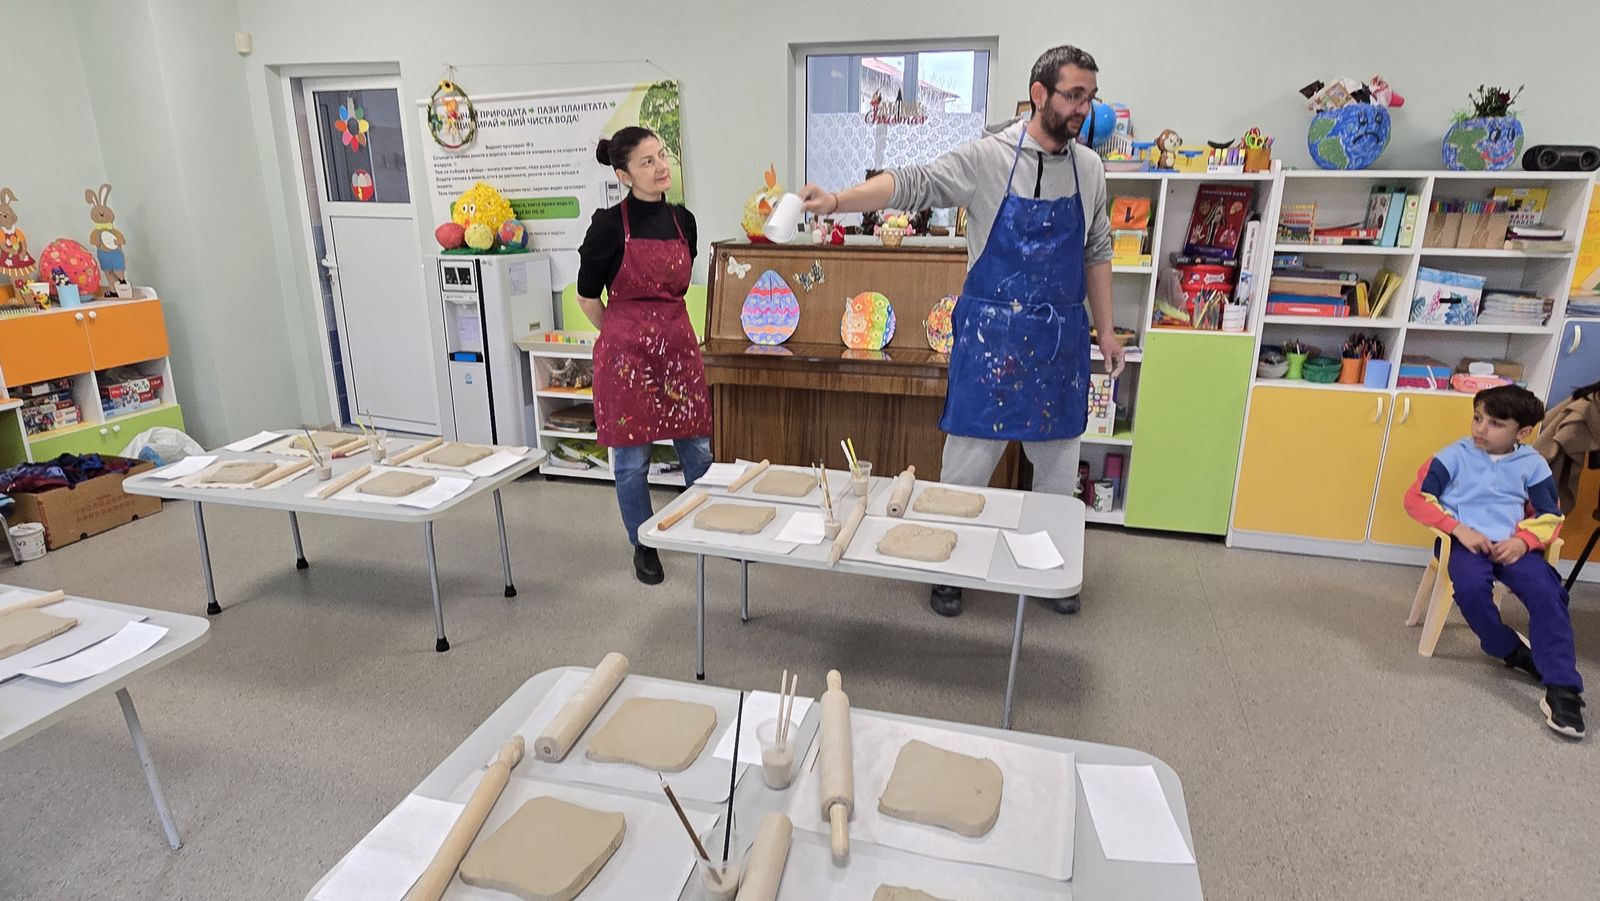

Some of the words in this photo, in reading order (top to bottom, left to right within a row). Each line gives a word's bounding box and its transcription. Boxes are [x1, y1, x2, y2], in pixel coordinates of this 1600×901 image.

[480, 107, 527, 119] ПРИРОДАТА
[537, 104, 560, 115] ПАЗИ
[561, 101, 608, 113] ПЛАНЕТАТА
[508, 116, 526, 127] ПИЙ
[527, 115, 554, 126] ЧИСТА
[555, 114, 580, 125] ВОДА!
